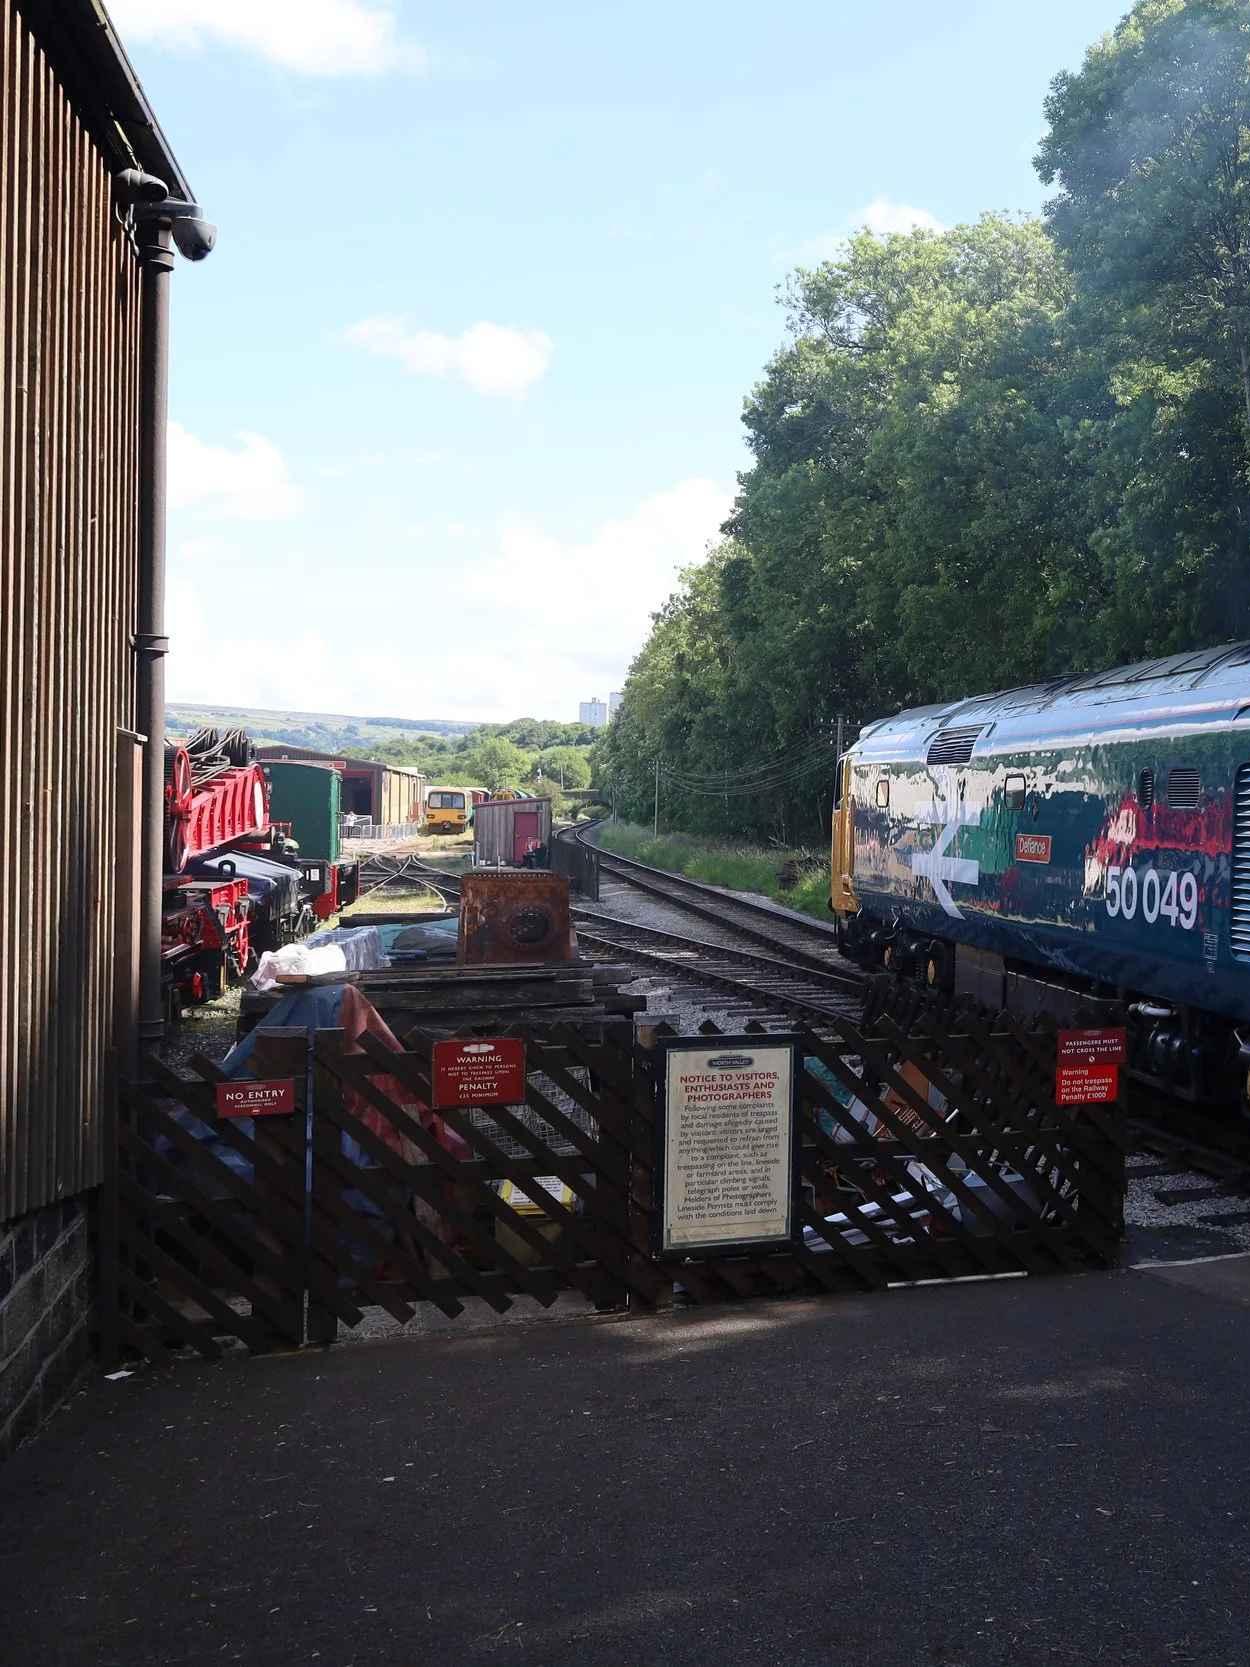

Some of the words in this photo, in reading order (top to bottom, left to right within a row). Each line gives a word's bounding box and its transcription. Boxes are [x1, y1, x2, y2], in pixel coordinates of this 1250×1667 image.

[1020, 837, 1046, 855] Defiance
[1106, 866, 1137, 920] 50
[1143, 869, 1197, 929] 049
[457, 1055, 502, 1063] WARNING
[681, 1075, 716, 1083] NOTICE
[736, 1072, 779, 1080] VISITORS,
[685, 1083, 750, 1093] ENTHUSIASTS
[249, 1090, 285, 1099] ENTRY
[688, 1091, 772, 1102] PHOTOGRAPHERS
[739, 1102, 774, 1110] complaints
[681, 1114, 689, 1122] by
[724, 1119, 752, 1127] allegedly
[758, 1126, 777, 1134] urged
[694, 1137, 728, 1145] requested
[679, 1146, 707, 1155] anything
[697, 1170, 726, 1178] farmland
[685, 1179, 717, 1188] particular
[749, 1175, 771, 1183] signals,
[688, 1187, 719, 1195] telegraph
[722, 1192, 771, 1201] Photographers
[709, 1210, 742, 1218] conditions
